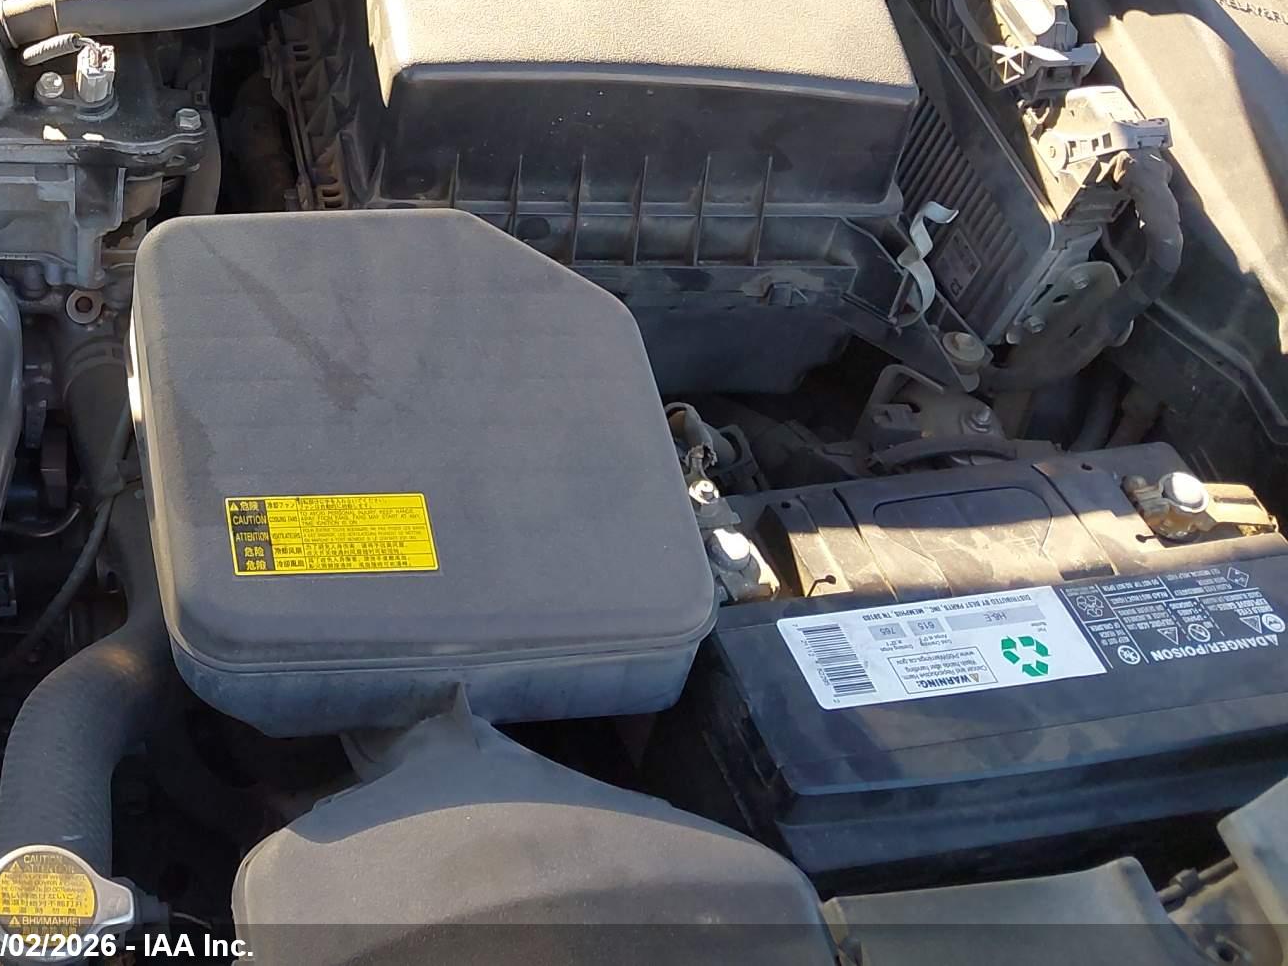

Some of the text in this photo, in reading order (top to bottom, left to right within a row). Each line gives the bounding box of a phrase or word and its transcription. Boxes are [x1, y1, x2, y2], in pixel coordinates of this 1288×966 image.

[232, 515, 267, 525] CAUTION
[235, 532, 270, 542] ATTENTION
[991, 594, 1033, 605] DISTRIBUTED
[917, 621, 936, 631] 615
[880, 627, 897, 636] 765
[1150, 635, 1269, 662] DANGER/POISON
[916, 673, 972, 689] WARNING:
